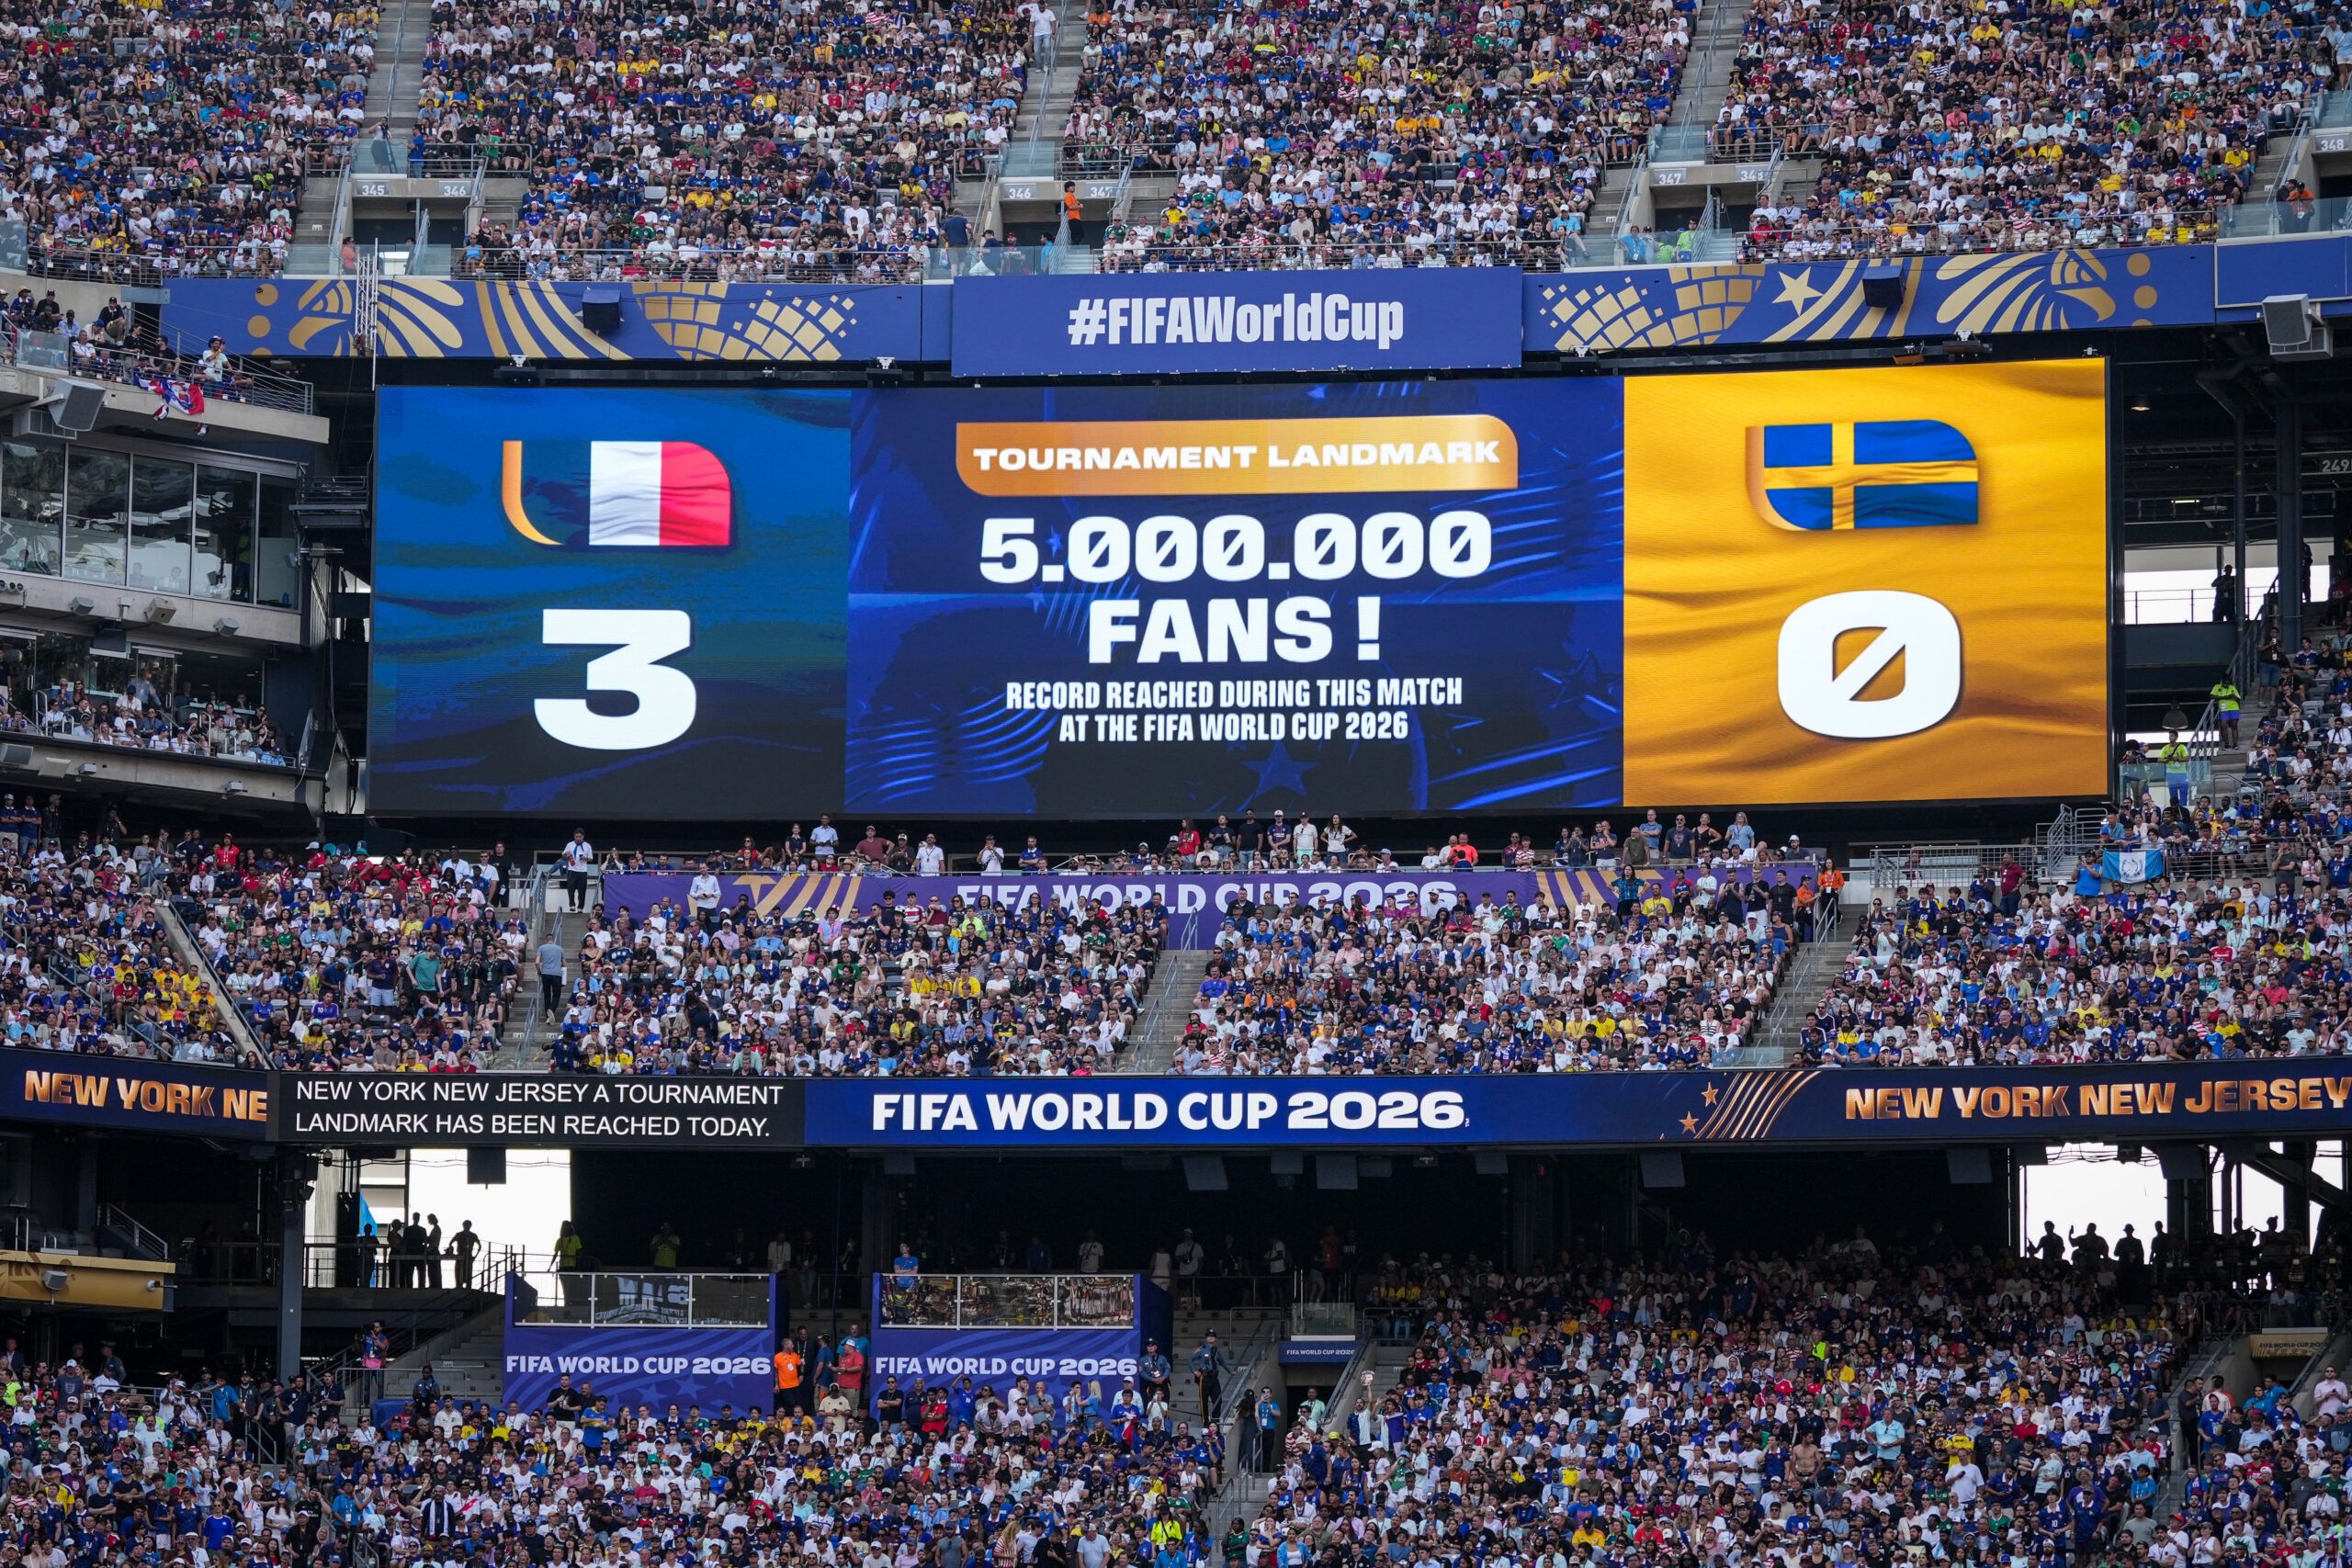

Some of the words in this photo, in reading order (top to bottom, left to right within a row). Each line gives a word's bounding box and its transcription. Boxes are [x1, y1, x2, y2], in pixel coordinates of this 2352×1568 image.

[2321, 138, 2345, 151] 348
[361, 185, 385, 196] 345
[443, 186, 467, 197] 346
[1008, 187, 1032, 198] 346
[1090, 186, 1113, 197] 347
[1658, 173, 1682, 185] 347
[1069, 293, 1403, 350] #FIFAWorldCup
[974, 445, 1258, 471] TOURNAMENT
[1268, 440, 1500, 468] LANDMARK
[2322, 458, 2352, 472] 249
[980, 511, 1492, 583] 5.000.000
[1090, 596, 1333, 663] FANS
[1778, 590, 1961, 738] 0
[535, 609, 697, 750] 3
[1006, 682, 1101, 710] RECORD
[1107, 682, 1213, 709] REACHED
[1219, 680, 1310, 708] DURING
[1317, 679, 1372, 706] THIS
[1378, 678, 1463, 706] MATCH
[1060, 716, 1090, 742] AT
[1095, 715, 1138, 742] THE
[1144, 715, 1193, 741] FIFA
[1200, 714, 1285, 741] WORLD
[1291, 713, 1340, 740] CUP
[1346, 712, 1408, 739] 2026
[25, 1070, 109, 1108] NEW
[117, 1077, 215, 1117] YORK
[223, 1089, 267, 1122] NE
[297, 1081, 353, 1100] NEW
[358, 1082, 426, 1101] YORK
[433, 1083, 490, 1101] NEW
[495, 1083, 589, 1103] JERSEY
[594, 1084, 610, 1103] A
[615, 1084, 784, 1105] TOURNAMENT
[1846, 1088, 1943, 1119] NEW
[1952, 1086, 2070, 1118] YORK
[2080, 1083, 2177, 1115] NEW
[2185, 1077, 2352, 1112] JERSEY
[873, 1094, 978, 1131] FIFA
[986, 1093, 1169, 1131] WORLD
[1179, 1092, 1278, 1131] CUP
[1287, 1091, 1464, 1130] 2026
[296, 1113, 429, 1134] LANDMARK
[435, 1114, 484, 1134] HAS
[492, 1115, 556, 1134] BEEN
[563, 1116, 680, 1135] REACHED
[687, 1117, 770, 1137] TODAY.
[506, 1356, 554, 1373] FIFA
[558, 1357, 639, 1374] WORLD
[643, 1357, 689, 1374] CUP
[692, 1358, 772, 1375] 2026
[876, 1357, 923, 1374] FIFA
[926, 1358, 1008, 1375] WORLD
[1012, 1358, 1056, 1375] CUP
[1058, 1359, 1138, 1376] 2026
